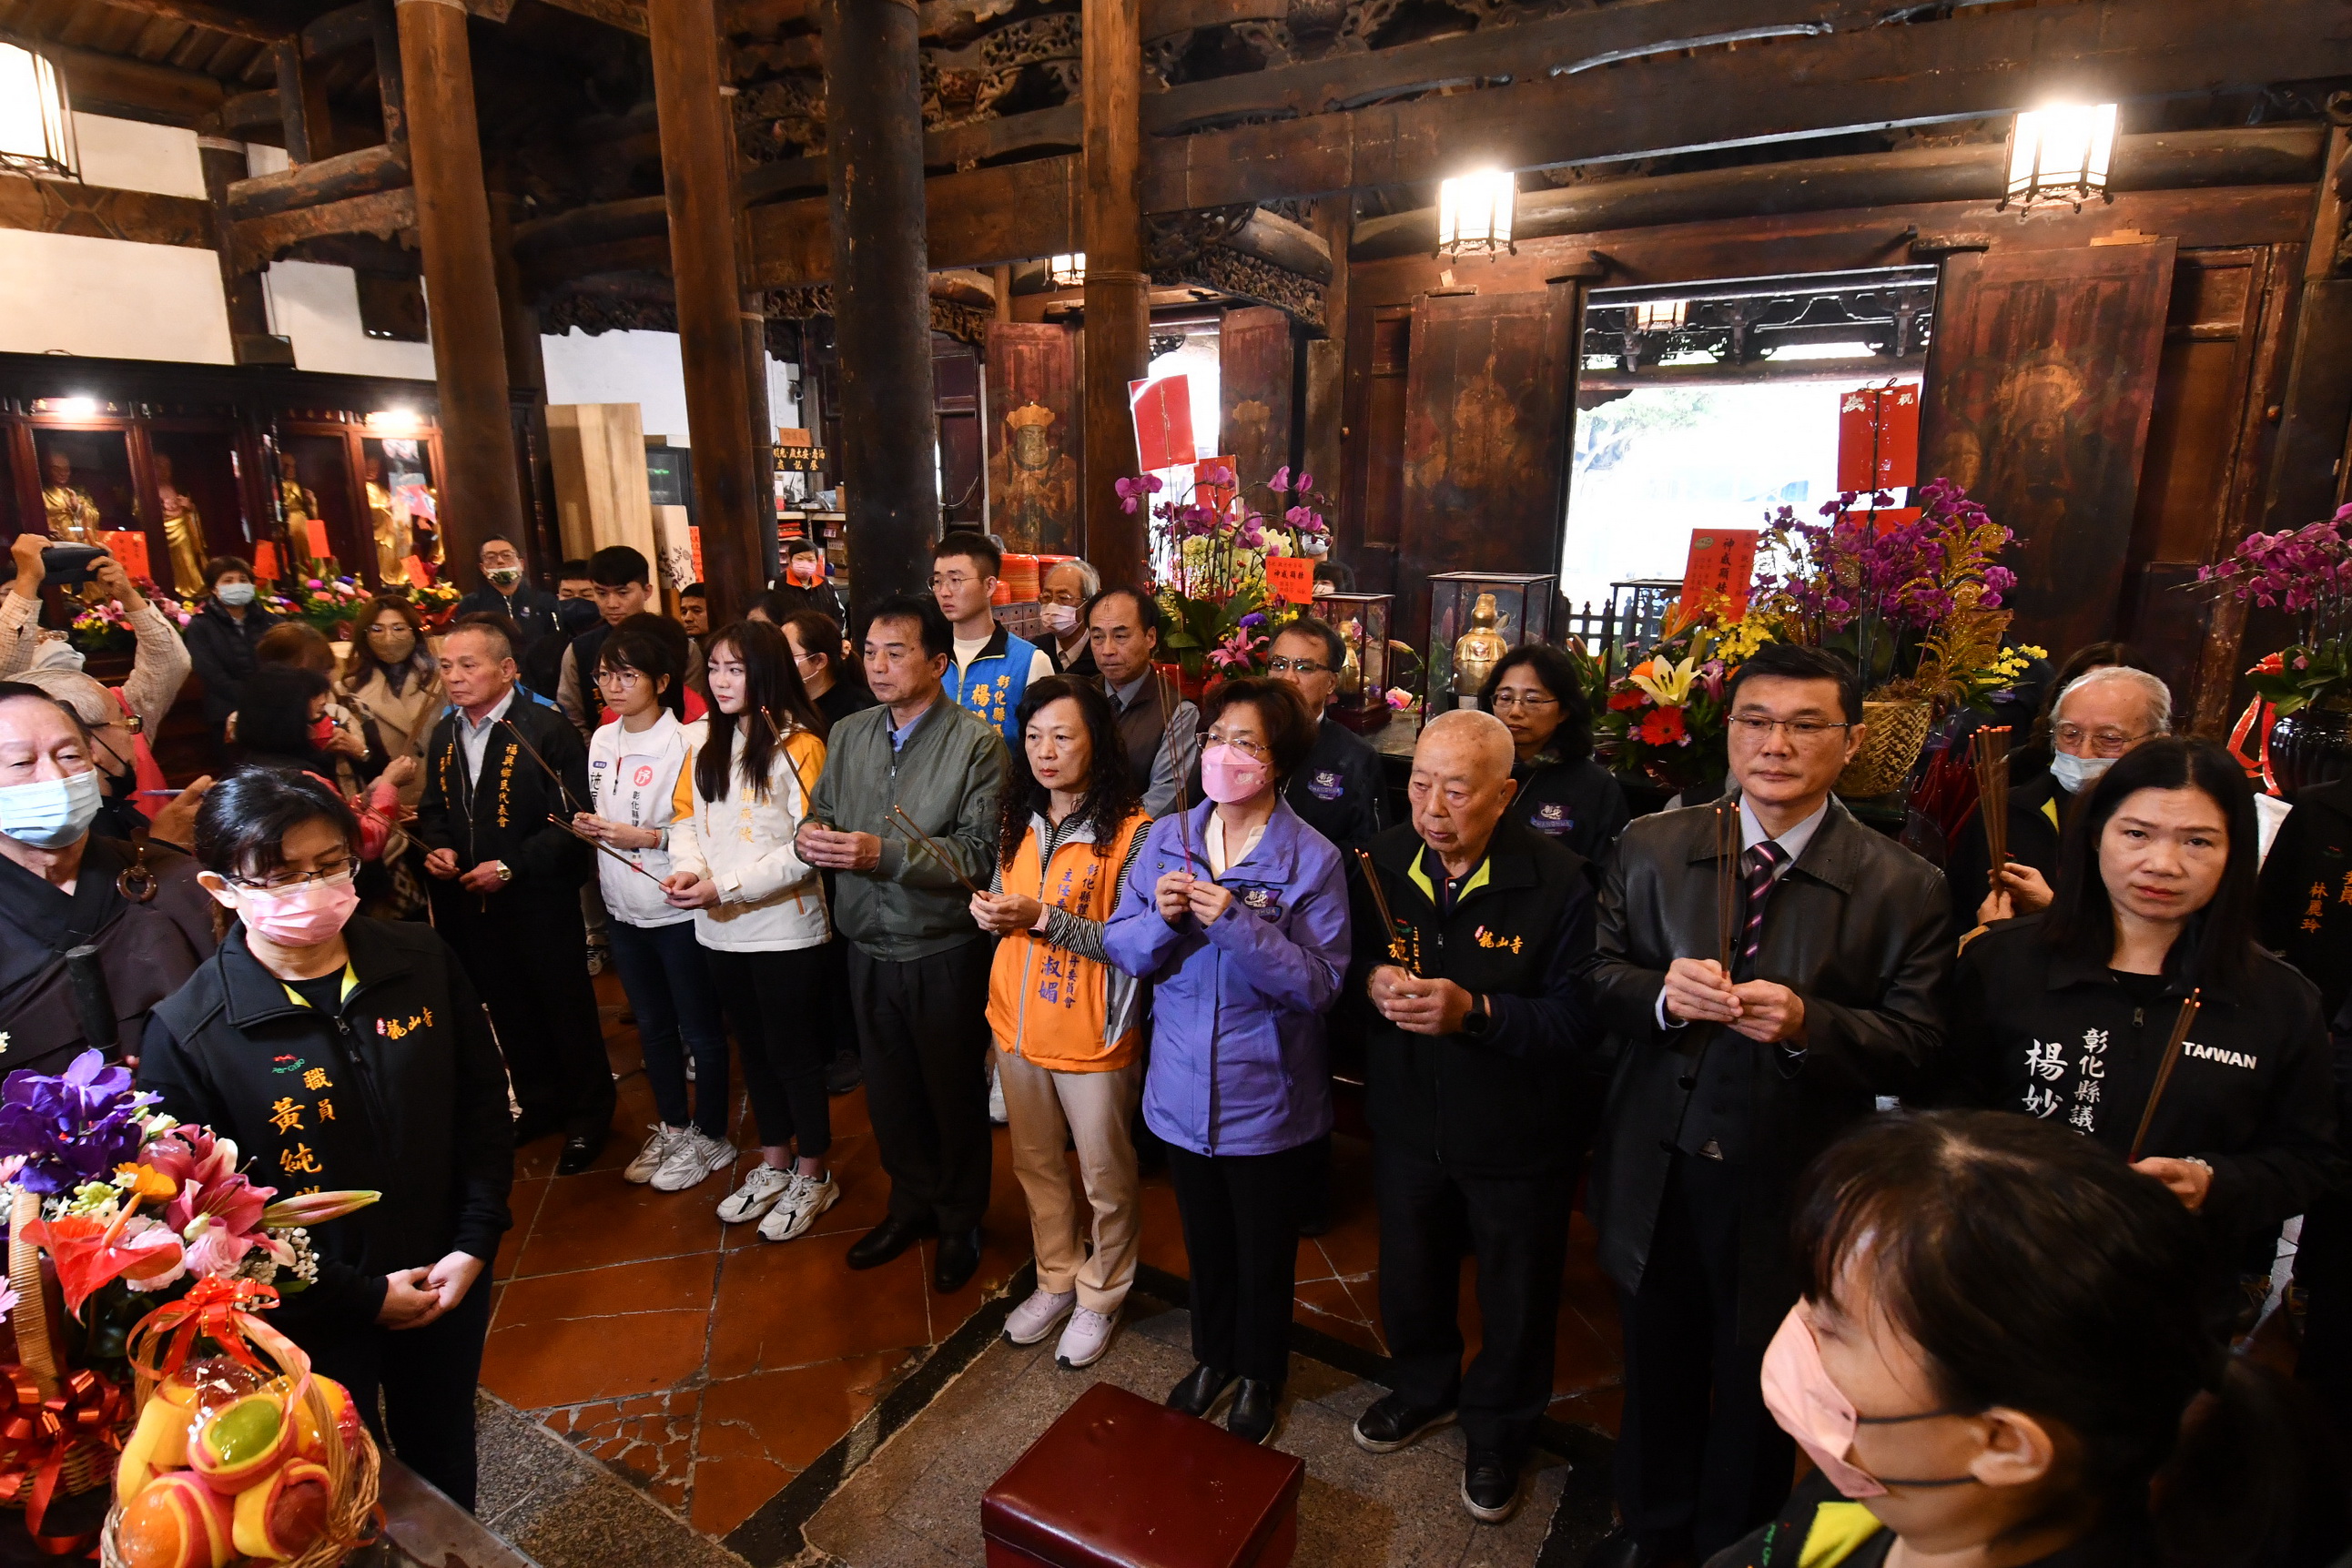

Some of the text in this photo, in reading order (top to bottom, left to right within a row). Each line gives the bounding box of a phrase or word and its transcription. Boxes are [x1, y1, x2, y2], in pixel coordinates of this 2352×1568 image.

[971, 683, 991, 721] 楊
[2022, 1038, 2068, 1119] 楊妙
[2068, 1027, 2110, 1136] 彰化縣議
[2182, 1041, 2258, 1070] TAIWAN
[302, 1067, 336, 1124] 職員
[269, 1097, 323, 1197] 黃純
